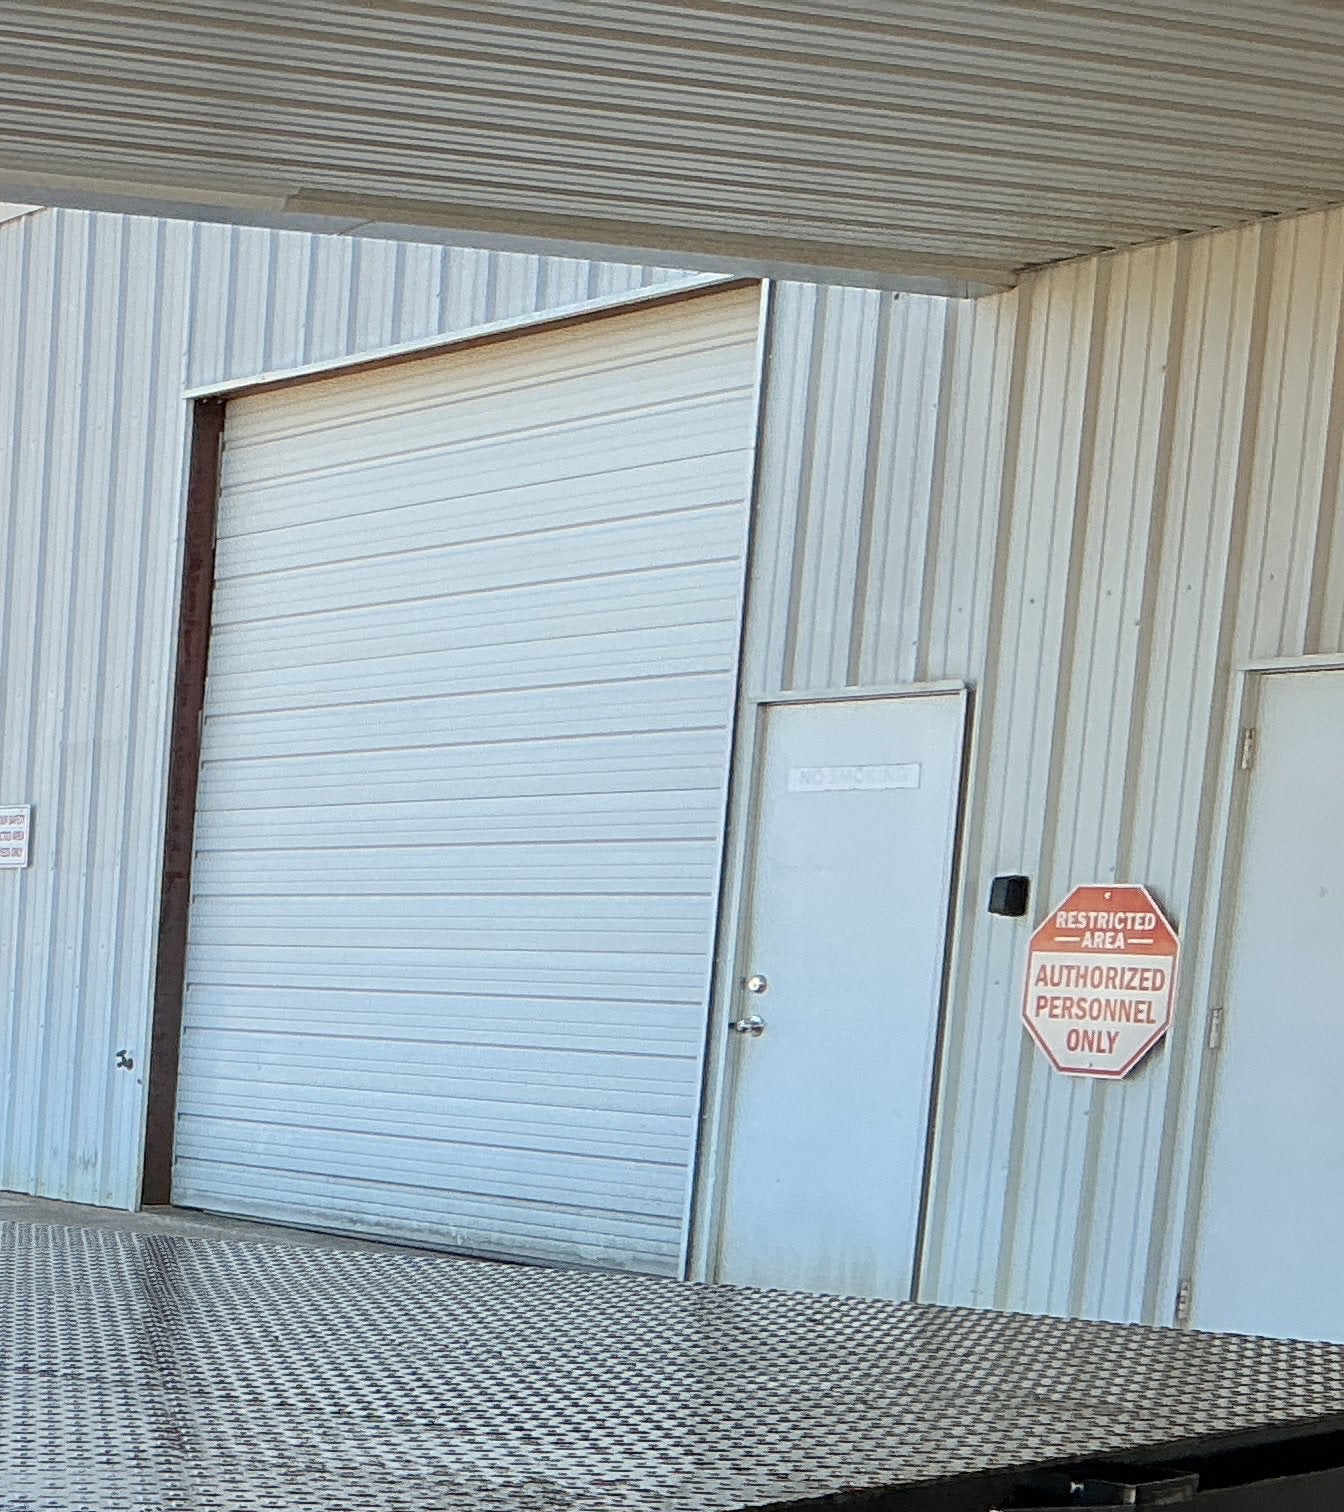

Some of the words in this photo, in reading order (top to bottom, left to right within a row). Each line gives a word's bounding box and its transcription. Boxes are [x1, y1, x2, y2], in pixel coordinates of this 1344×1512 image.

[1055, 910, 1157, 931] RESTRICTED
[1081, 931, 1126, 950] AREA
[1034, 963, 1166, 992] AUTHORIZED
[1035, 995, 1157, 1025] PERSONNEL
[1066, 1028, 1120, 1054] ONLY
